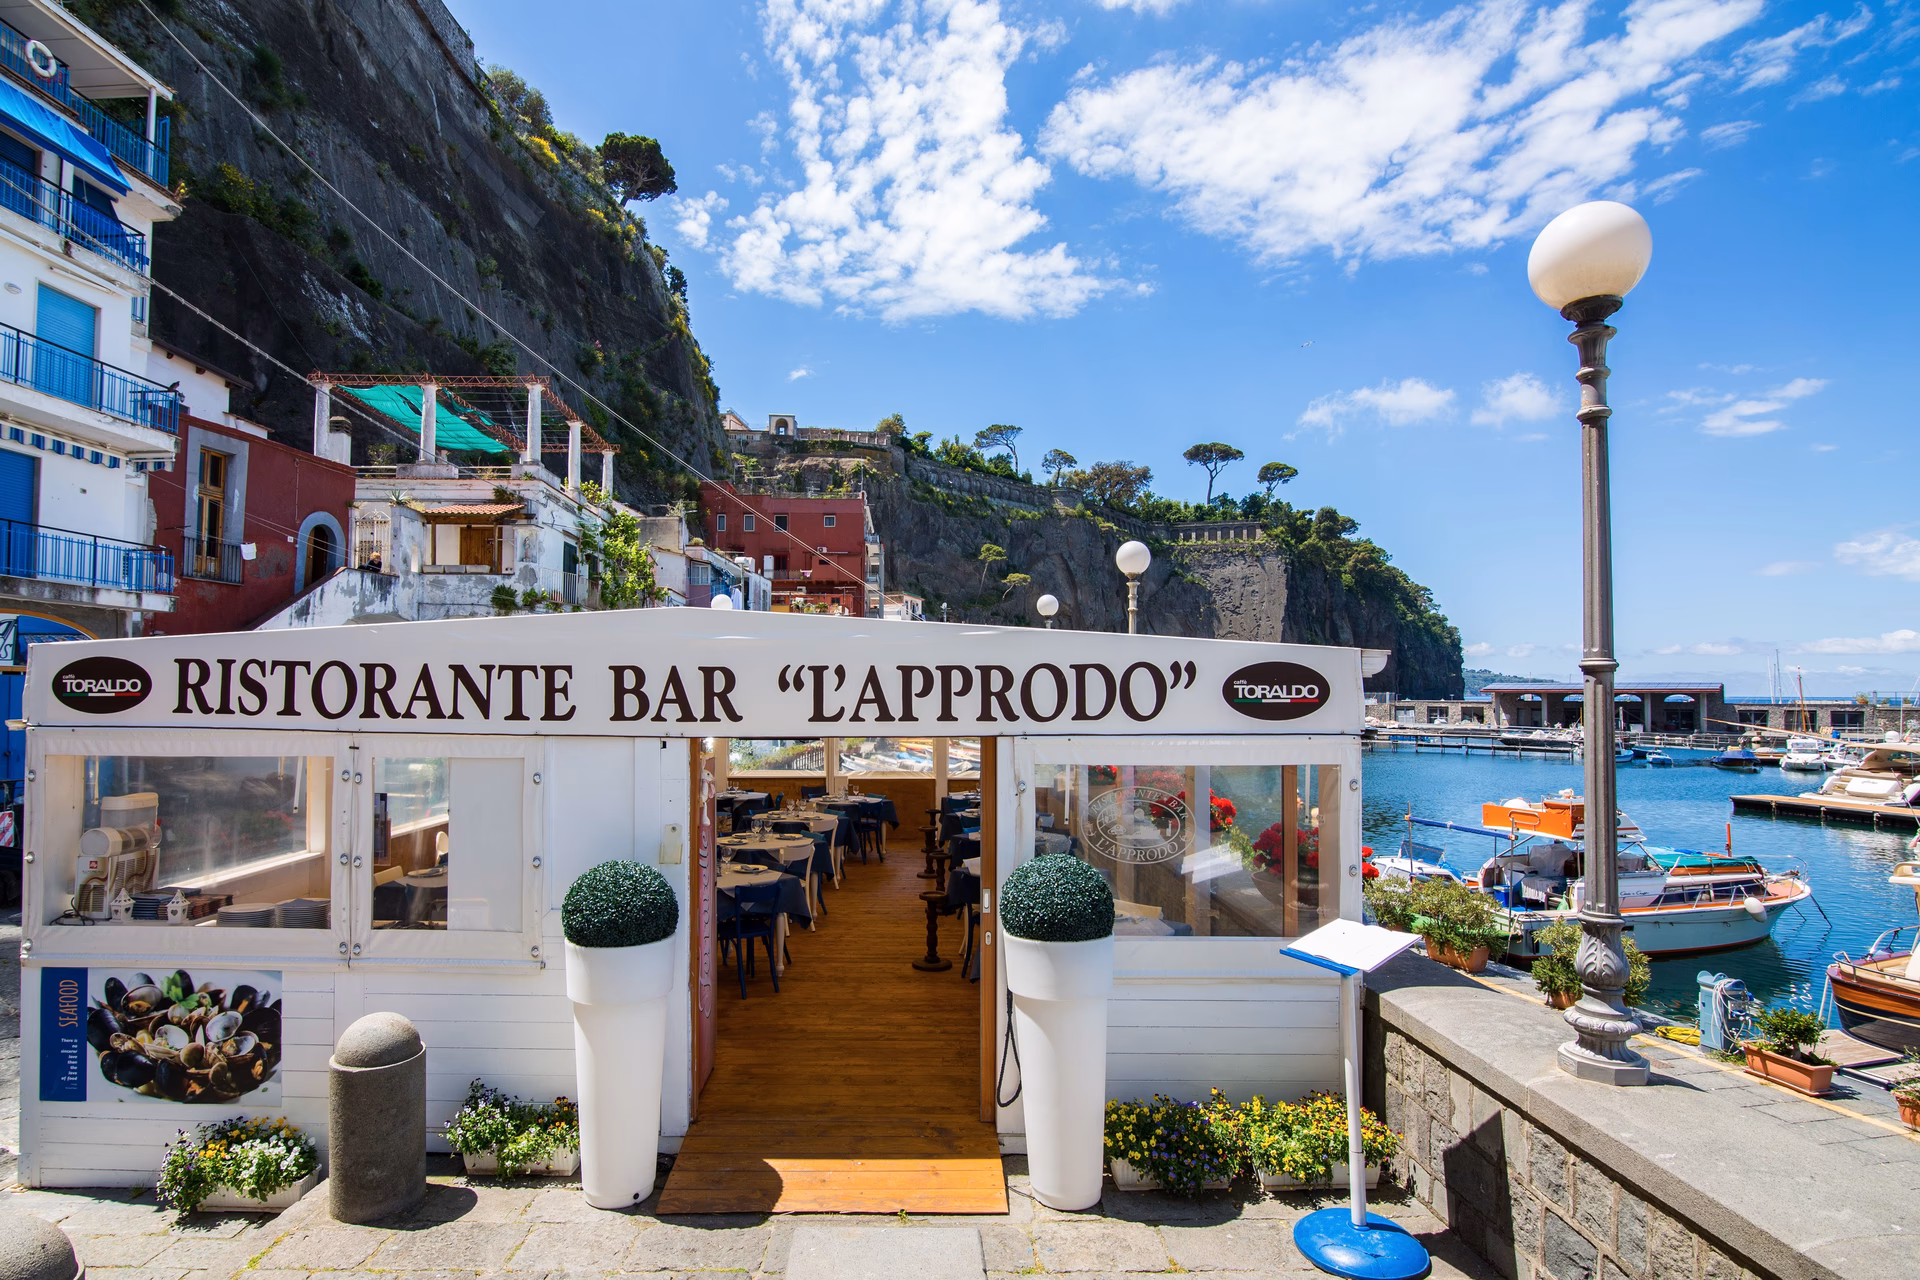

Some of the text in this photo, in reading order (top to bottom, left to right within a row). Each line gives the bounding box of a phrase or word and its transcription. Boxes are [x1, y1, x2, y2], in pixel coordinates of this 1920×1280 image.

[62, 679, 142, 692] TORALDO
[172, 658, 576, 721] RISTORANTE
[608, 665, 744, 722] BAR
[1233, 685, 1319, 698] TORALDO
[1168, 801, 1189, 819] BAR
[59, 980, 79, 1027] SEAFOOD
